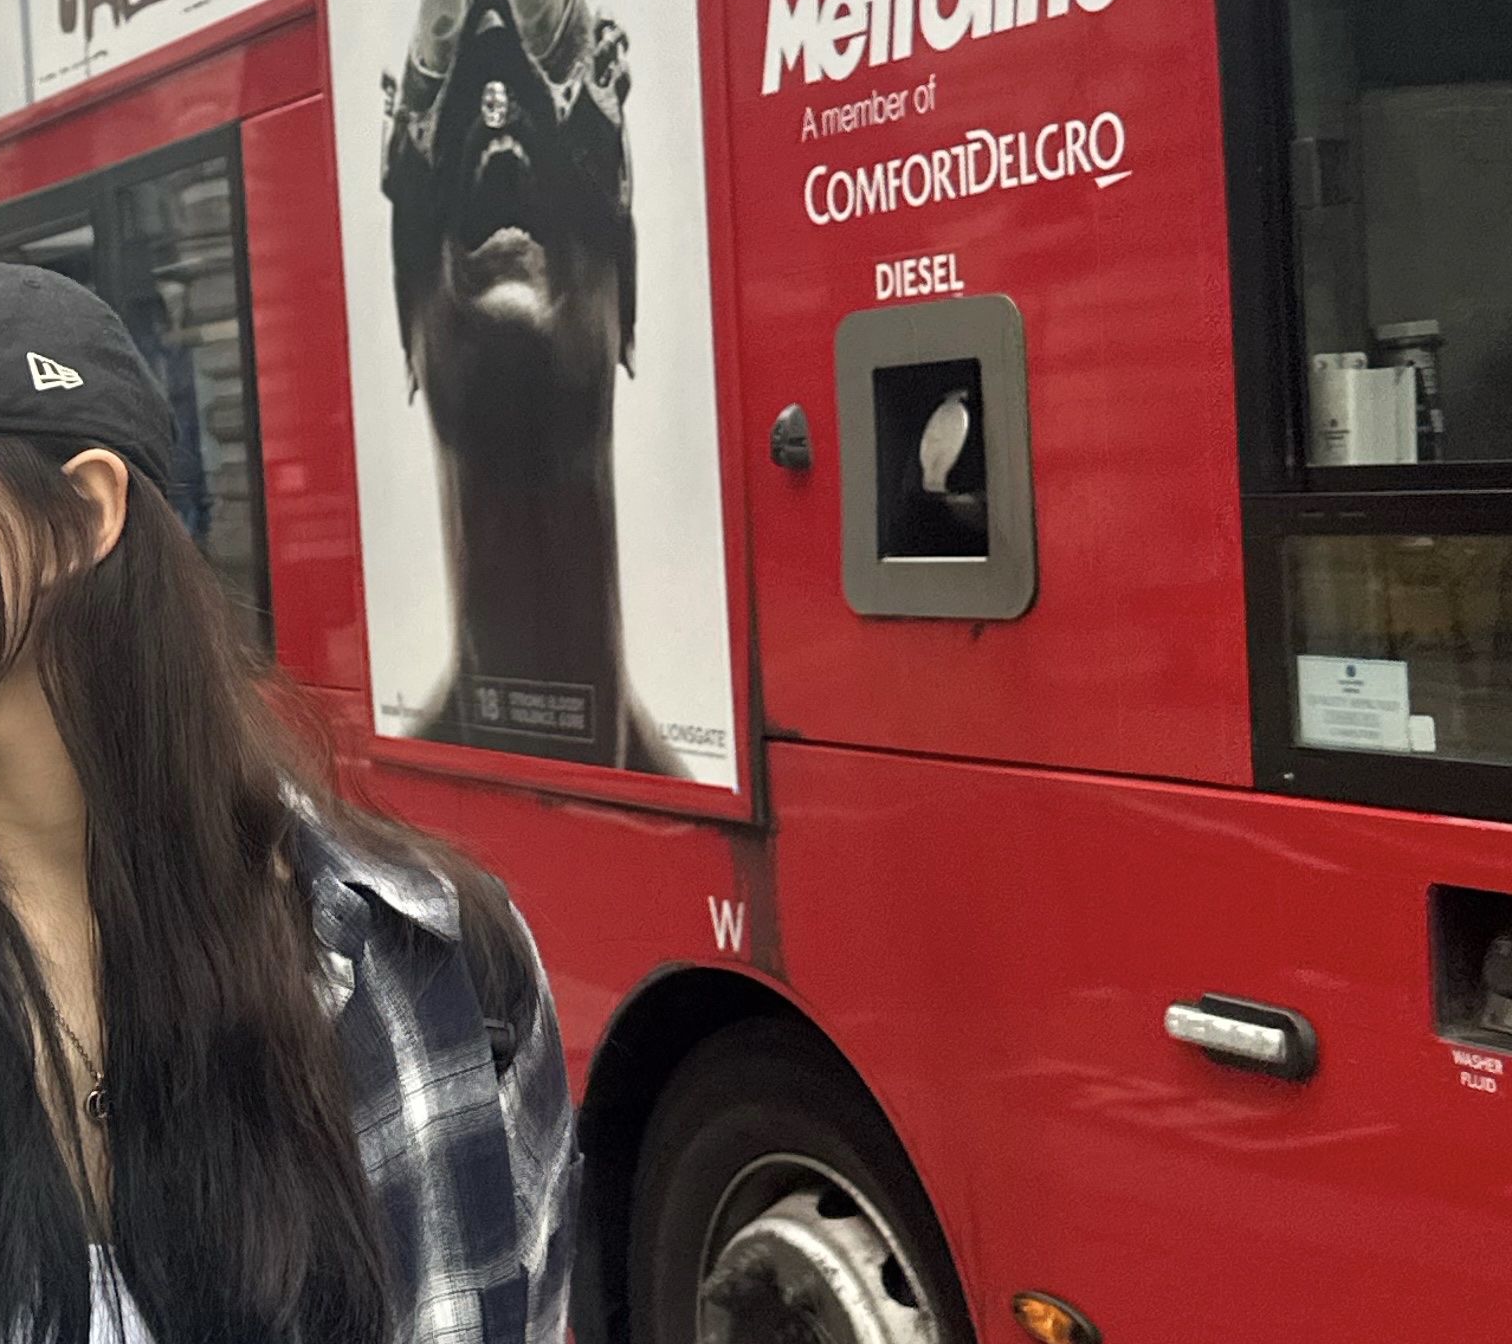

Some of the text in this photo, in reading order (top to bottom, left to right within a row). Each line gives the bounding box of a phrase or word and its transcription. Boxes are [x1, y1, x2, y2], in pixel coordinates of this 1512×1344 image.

[801, 73, 937, 143] A member of
[875, 253, 965, 301] DIESEL
[707, 895, 745, 953] W
[1460, 1070, 1497, 1094] FLUID
